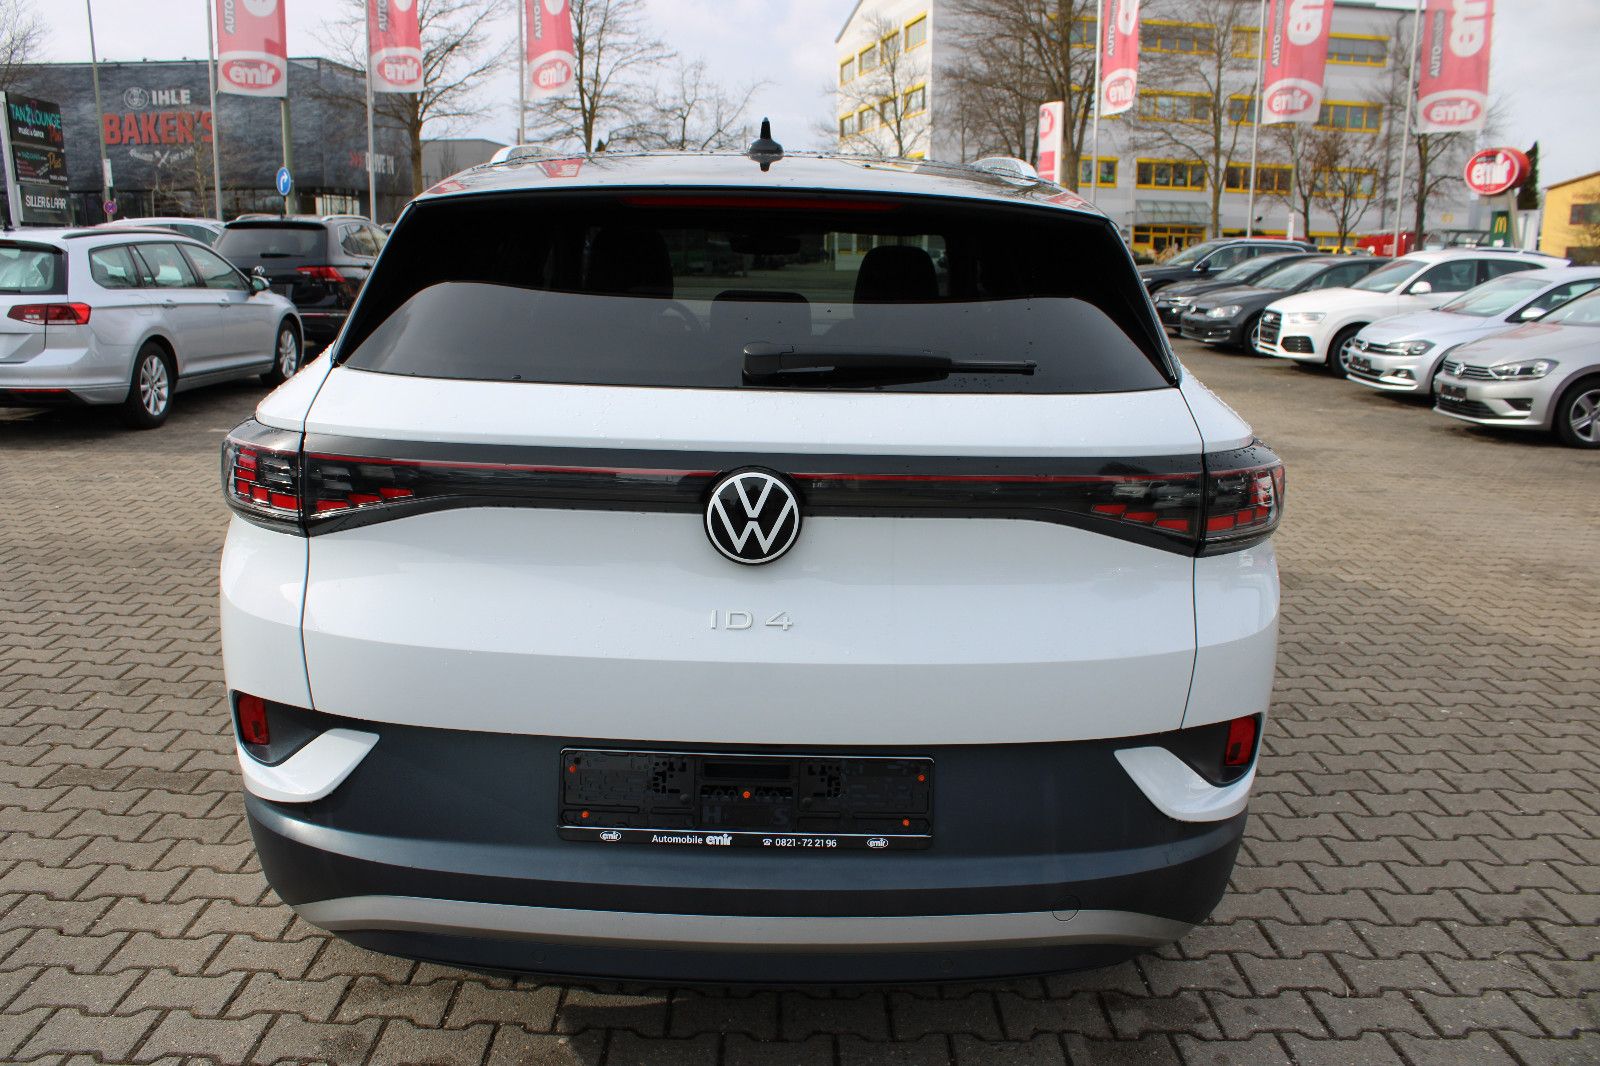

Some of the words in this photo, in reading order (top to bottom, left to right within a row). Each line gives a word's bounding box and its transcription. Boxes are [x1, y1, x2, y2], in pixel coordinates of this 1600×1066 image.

[229, 63, 275, 85] emir
[152, 89, 191, 106] IHLE
[1429, 99, 1477, 122] emir
[102, 111, 213, 145] BAKER'S
[1470, 152, 1511, 186] emir
[602, 830, 621, 841] emir
[652, 834, 703, 845] Automobile
[705, 833, 733, 846] emir
[869, 838, 886, 848] emir
